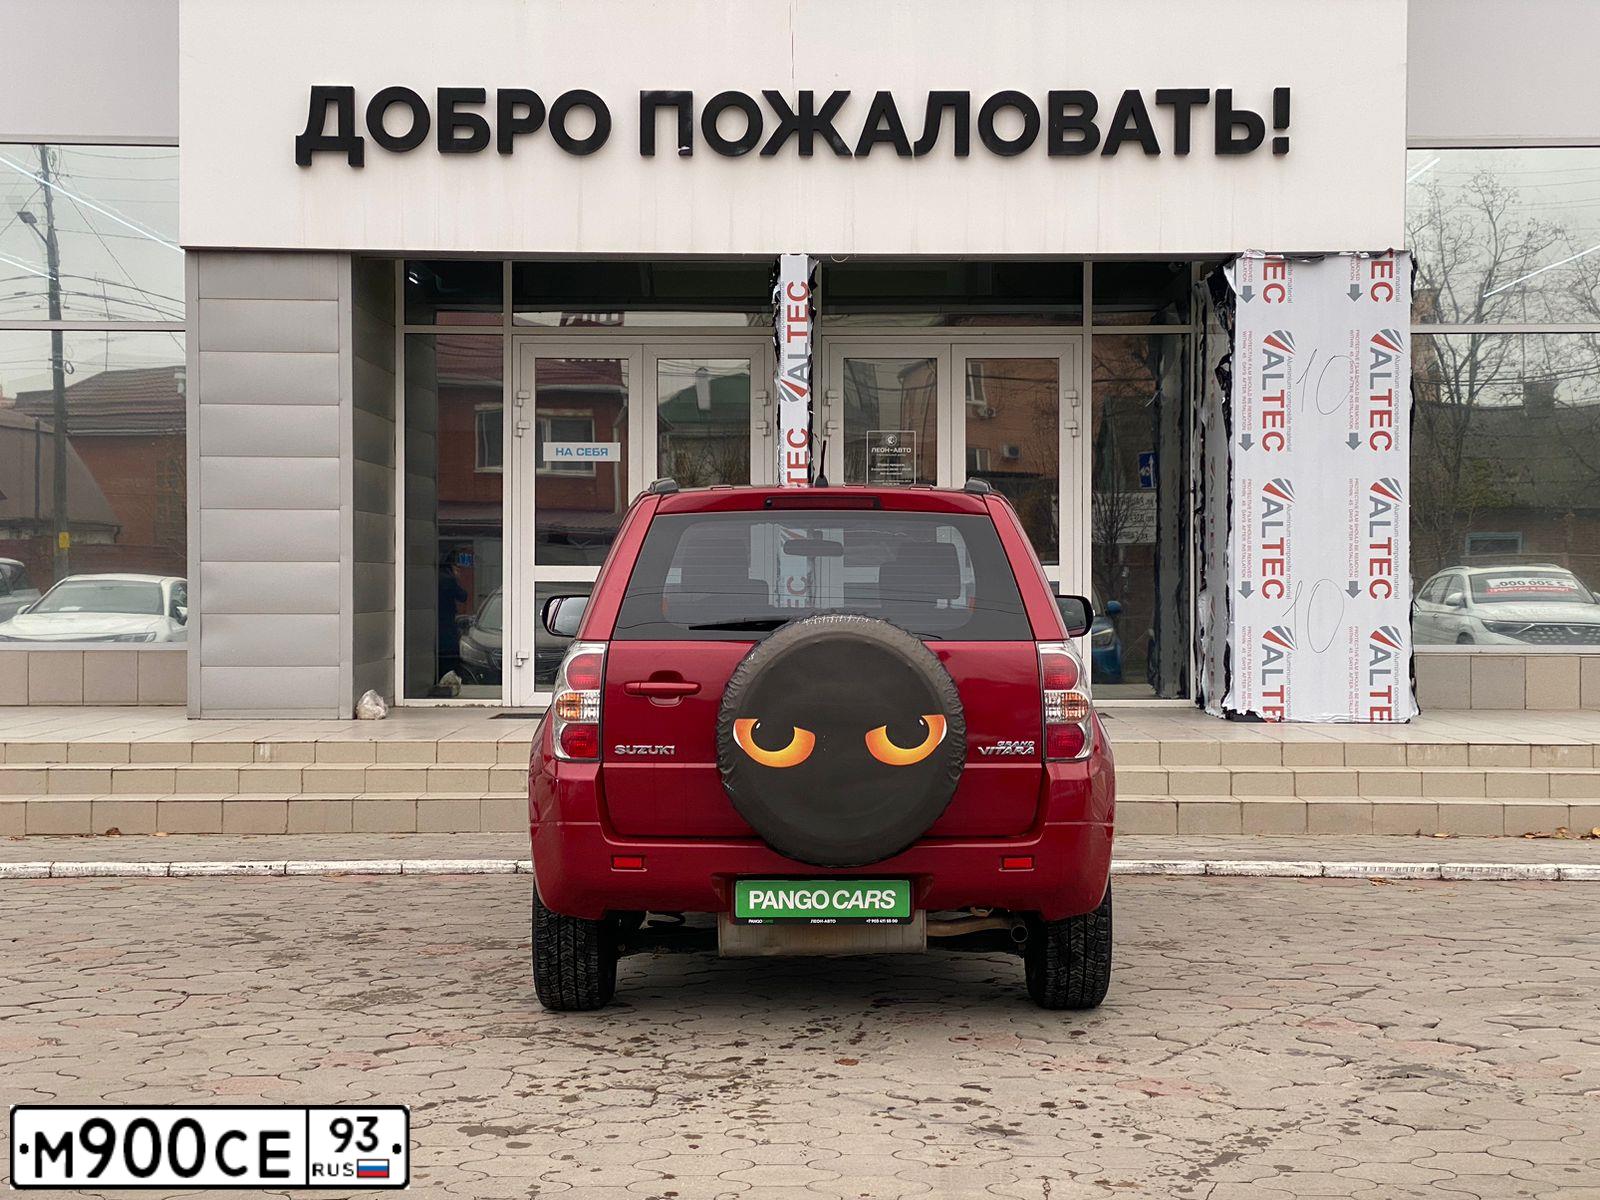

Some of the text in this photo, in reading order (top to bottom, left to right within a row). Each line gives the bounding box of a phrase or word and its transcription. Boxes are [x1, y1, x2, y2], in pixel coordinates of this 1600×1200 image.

[296, 86, 1290, 167] ДОБРО ПОЖАЛОВАТЬ!
[1262, 256, 1285, 304] EC
[786, 281, 808, 384] ALTEC
[1262, 348, 1284, 452] ALTEC
[1296, 348, 1357, 415] 10
[1370, 347, 1392, 451] ALTEC
[556, 448, 608, 456] НА СЕБЯ
[1262, 496, 1284, 599] ALTEC
[1370, 496, 1392, 599] ALTEC
[1282, 579, 1344, 654] 10
[614, 744, 675, 755] SUZUKI
[978, 746, 1035, 755] VITARA
[749, 890, 896, 910] PANGO CARS
